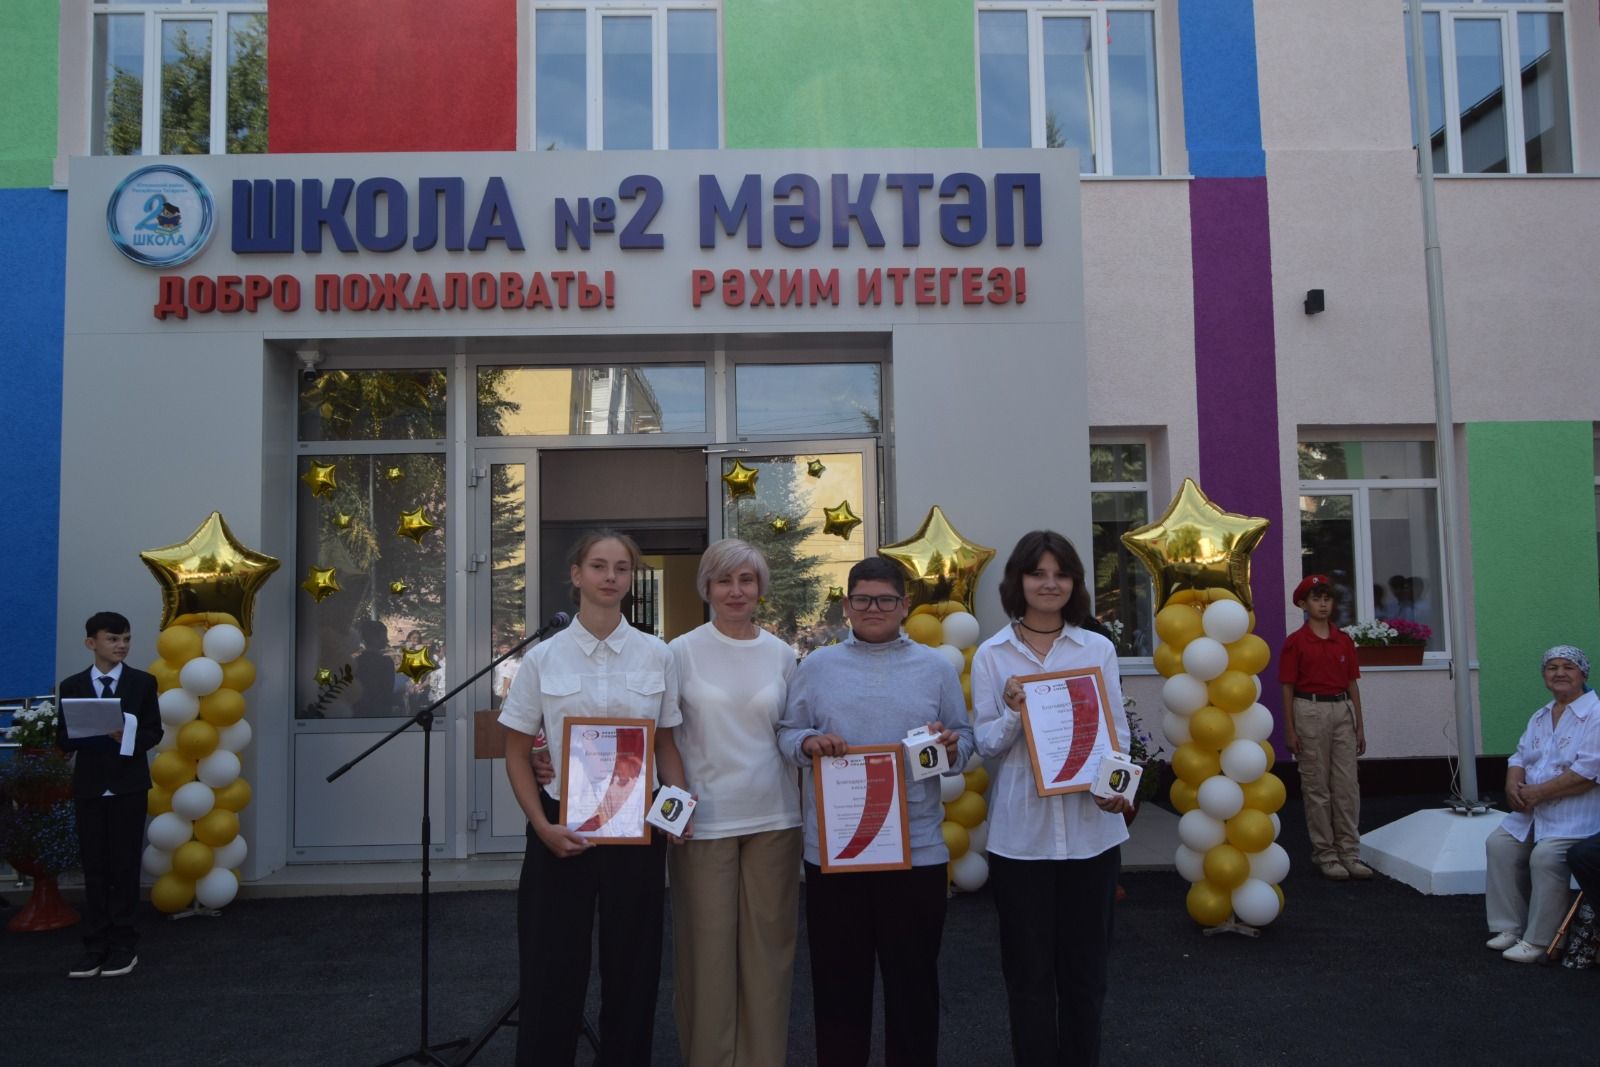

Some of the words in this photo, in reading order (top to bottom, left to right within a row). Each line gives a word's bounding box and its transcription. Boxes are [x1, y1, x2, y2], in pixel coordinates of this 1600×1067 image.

[134, 193, 167, 231] 2
[232, 177, 525, 254] ШКОЛА
[555, 174, 664, 251] №2
[699, 173, 1043, 249] МӘКТӘП
[133, 234, 186, 246] ШКОЛА
[154, 273, 301, 321] ДОБРО
[314, 271, 615, 312] ПОЖАЛОВАТЬ!
[692, 268, 840, 308] РӘХИМ
[857, 267, 1027, 306] ИТЕГЕЗ!
